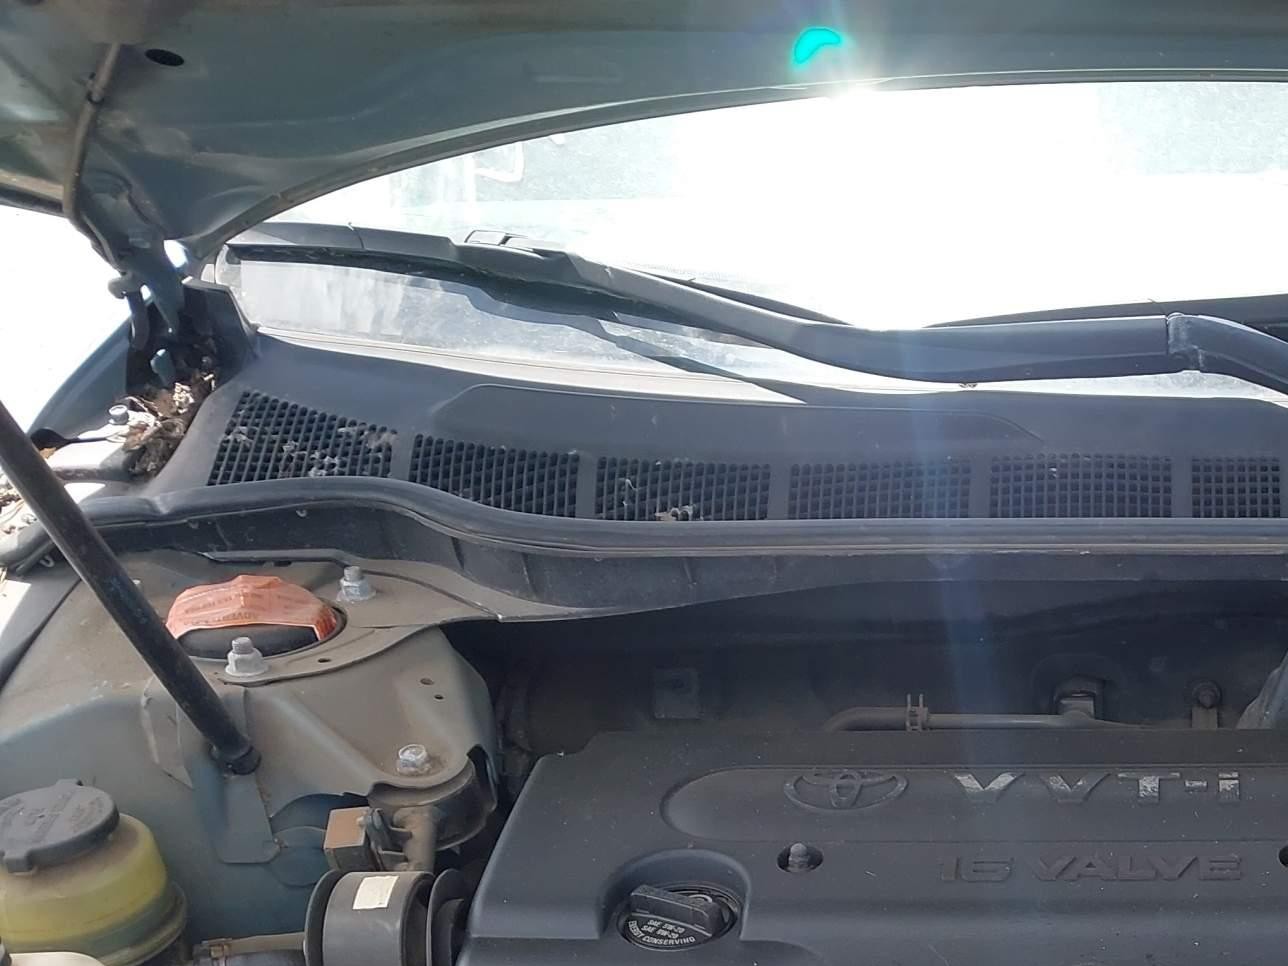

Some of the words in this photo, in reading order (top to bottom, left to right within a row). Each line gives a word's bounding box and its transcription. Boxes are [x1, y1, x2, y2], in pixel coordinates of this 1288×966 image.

[939, 856, 1014, 883] 16
[1034, 854, 1242, 882] VALVE
[647, 919, 663, 928] SAE
[640, 924, 657, 934] SAE
[641, 935, 696, 945] CONSERVING
